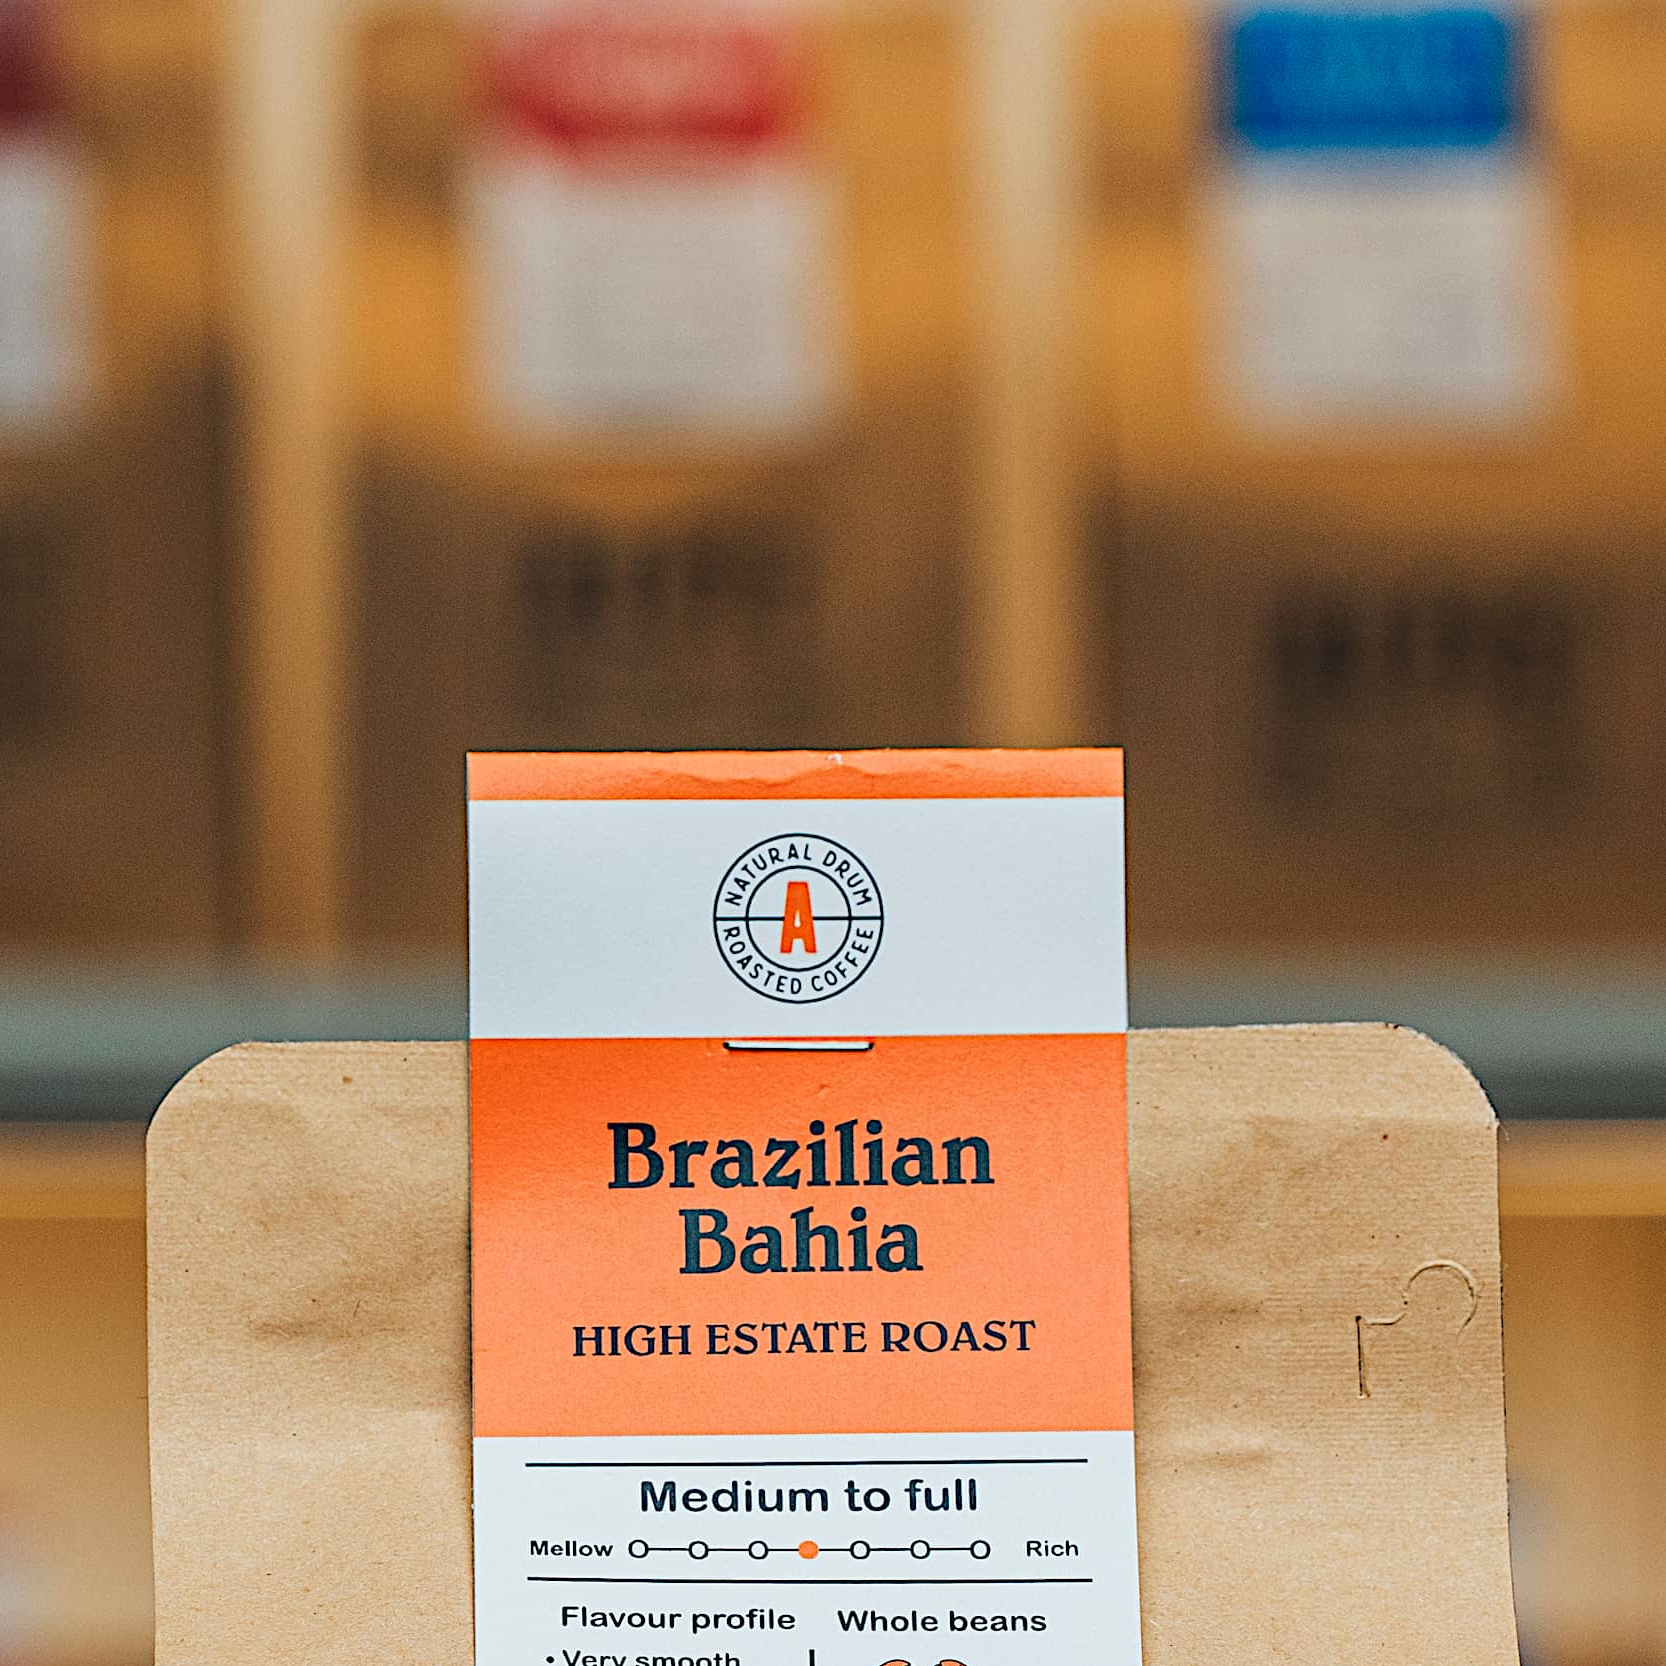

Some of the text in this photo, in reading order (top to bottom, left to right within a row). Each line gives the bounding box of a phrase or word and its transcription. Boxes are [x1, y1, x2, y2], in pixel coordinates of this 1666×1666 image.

[724, 843, 872, 906] NATURAL DRUM
[780, 881, 817, 954] A
[723, 926, 873, 994] ROASTED COFFEE
[606, 1118, 995, 1190] Brazilian
[678, 1206, 924, 1275] Bahia
[572, 1319, 1036, 1357] HIGH ESTATE ROAST
[640, 1478, 977, 1513] Medium to full
[530, 1540, 614, 1557] Mellow
[1026, 1539, 1079, 1557] Rich
[561, 1605, 796, 1635] Flavour profile
[837, 1610, 1047, 1632] Whole beans
